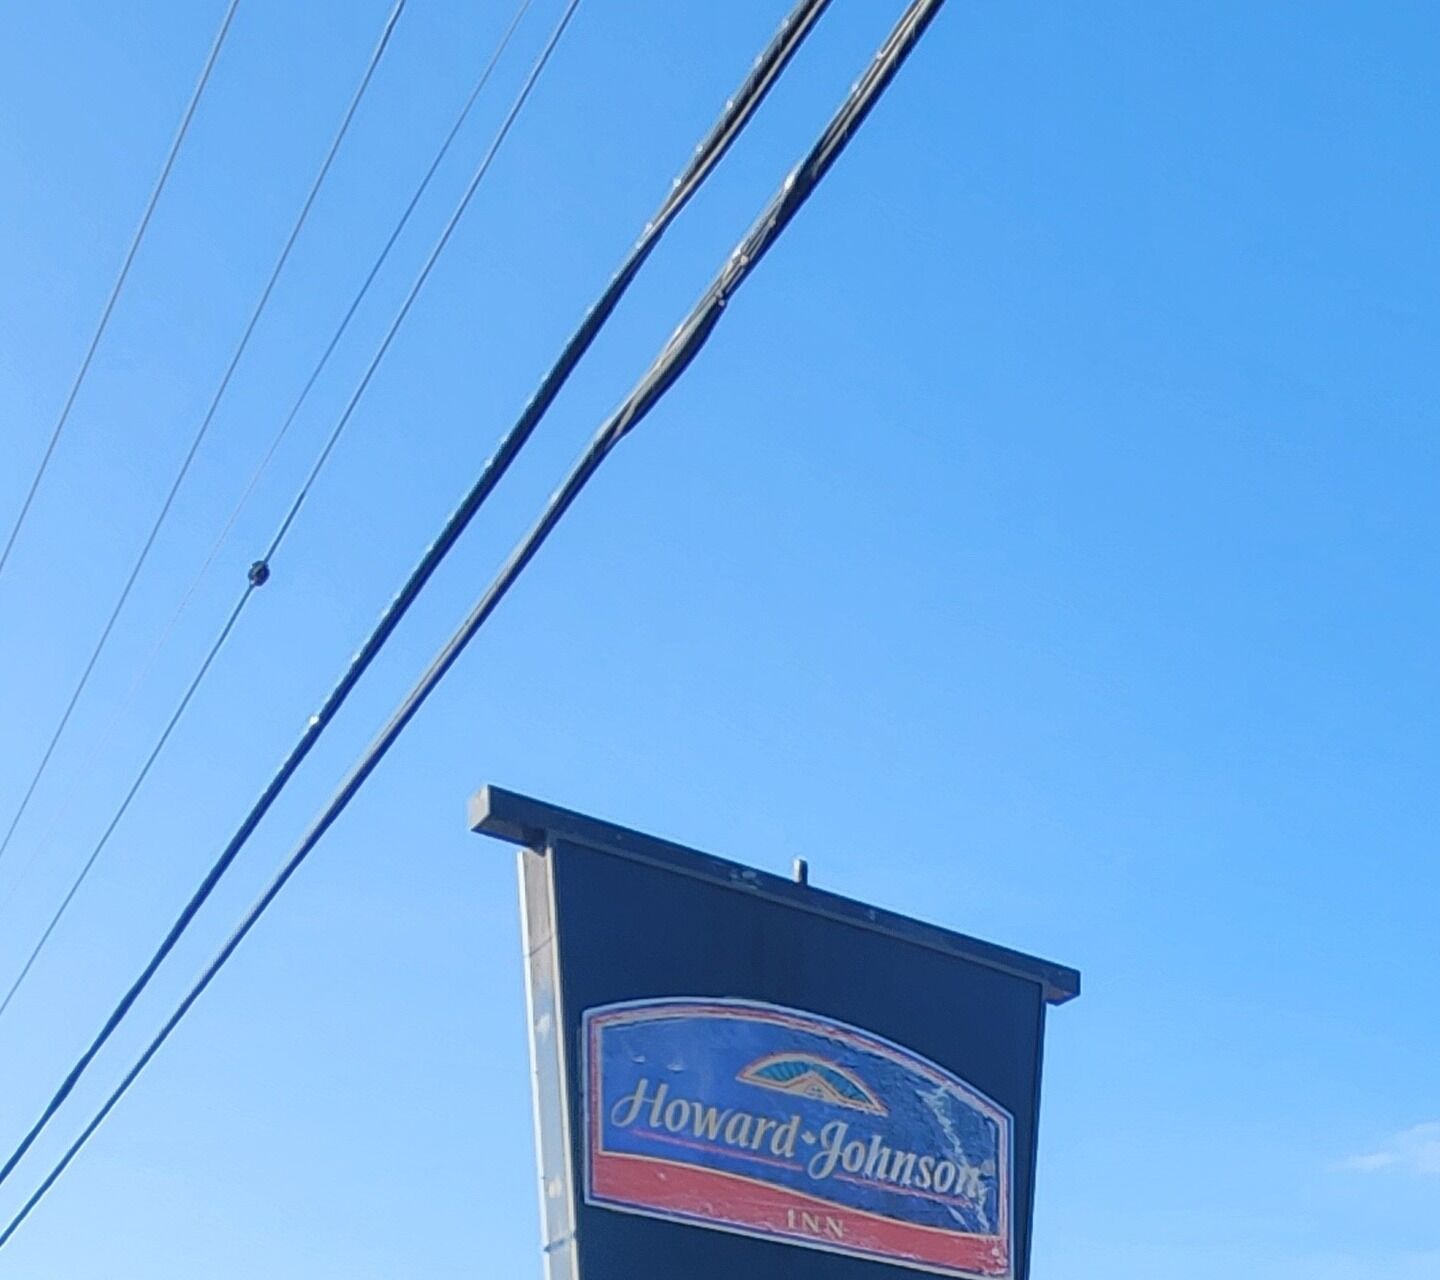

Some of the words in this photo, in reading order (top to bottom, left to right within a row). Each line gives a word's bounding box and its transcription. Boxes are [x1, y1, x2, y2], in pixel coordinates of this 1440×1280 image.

[611, 1078, 799, 1158] Howard
[808, 1119, 986, 1200] Johnson
[786, 1208, 845, 1238] INN
